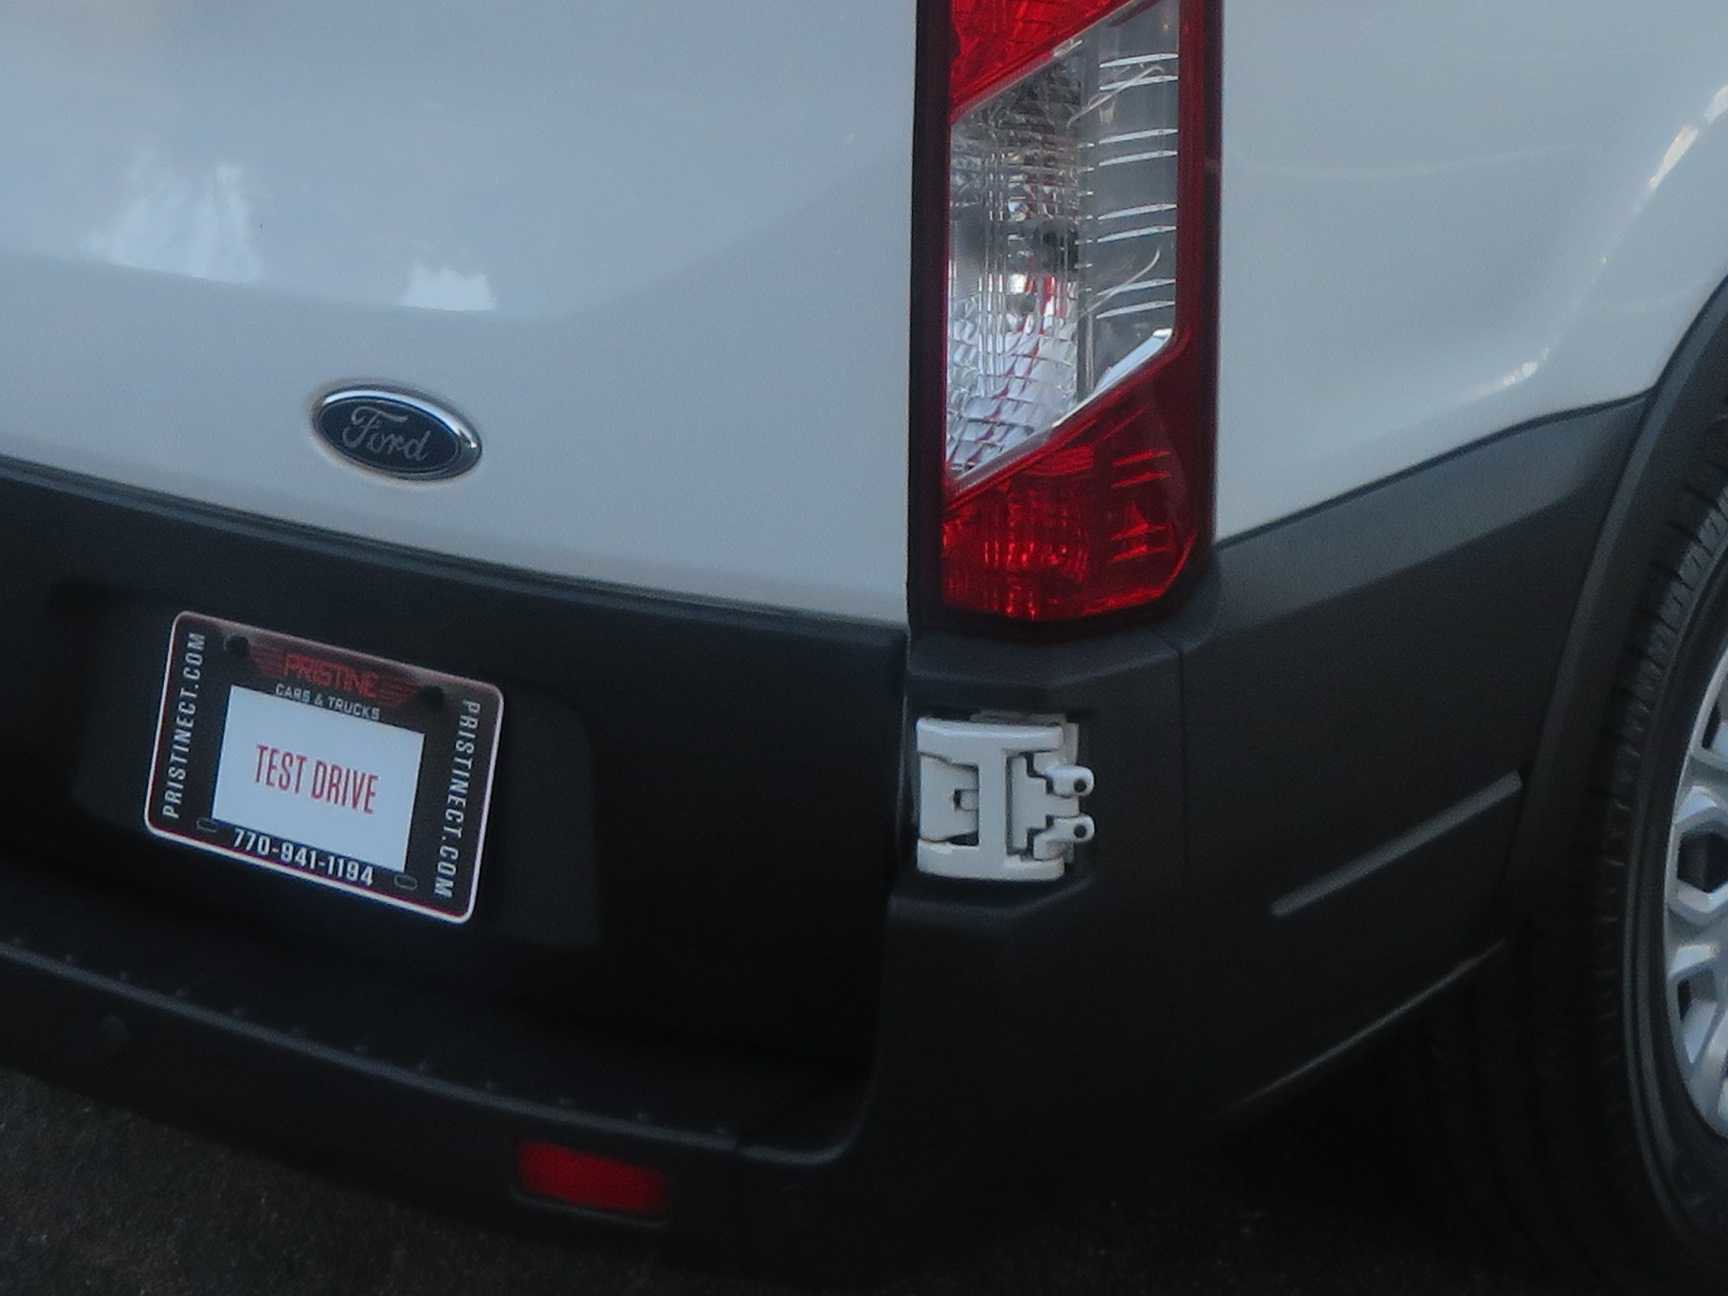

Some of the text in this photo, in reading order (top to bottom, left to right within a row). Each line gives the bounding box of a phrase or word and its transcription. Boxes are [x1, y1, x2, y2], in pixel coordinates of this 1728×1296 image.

[342, 406, 431, 462] Ford
[275, 683, 381, 721] CARS & TRUCKS
[283, 653, 379, 698] PRISTINE
[162, 632, 206, 819] PRISTINECT.COM
[254, 745, 379, 815] TEST DRIVE
[434, 699, 481, 899] PRISTINECT.COM
[233, 827, 374, 886] 770-941-1194
